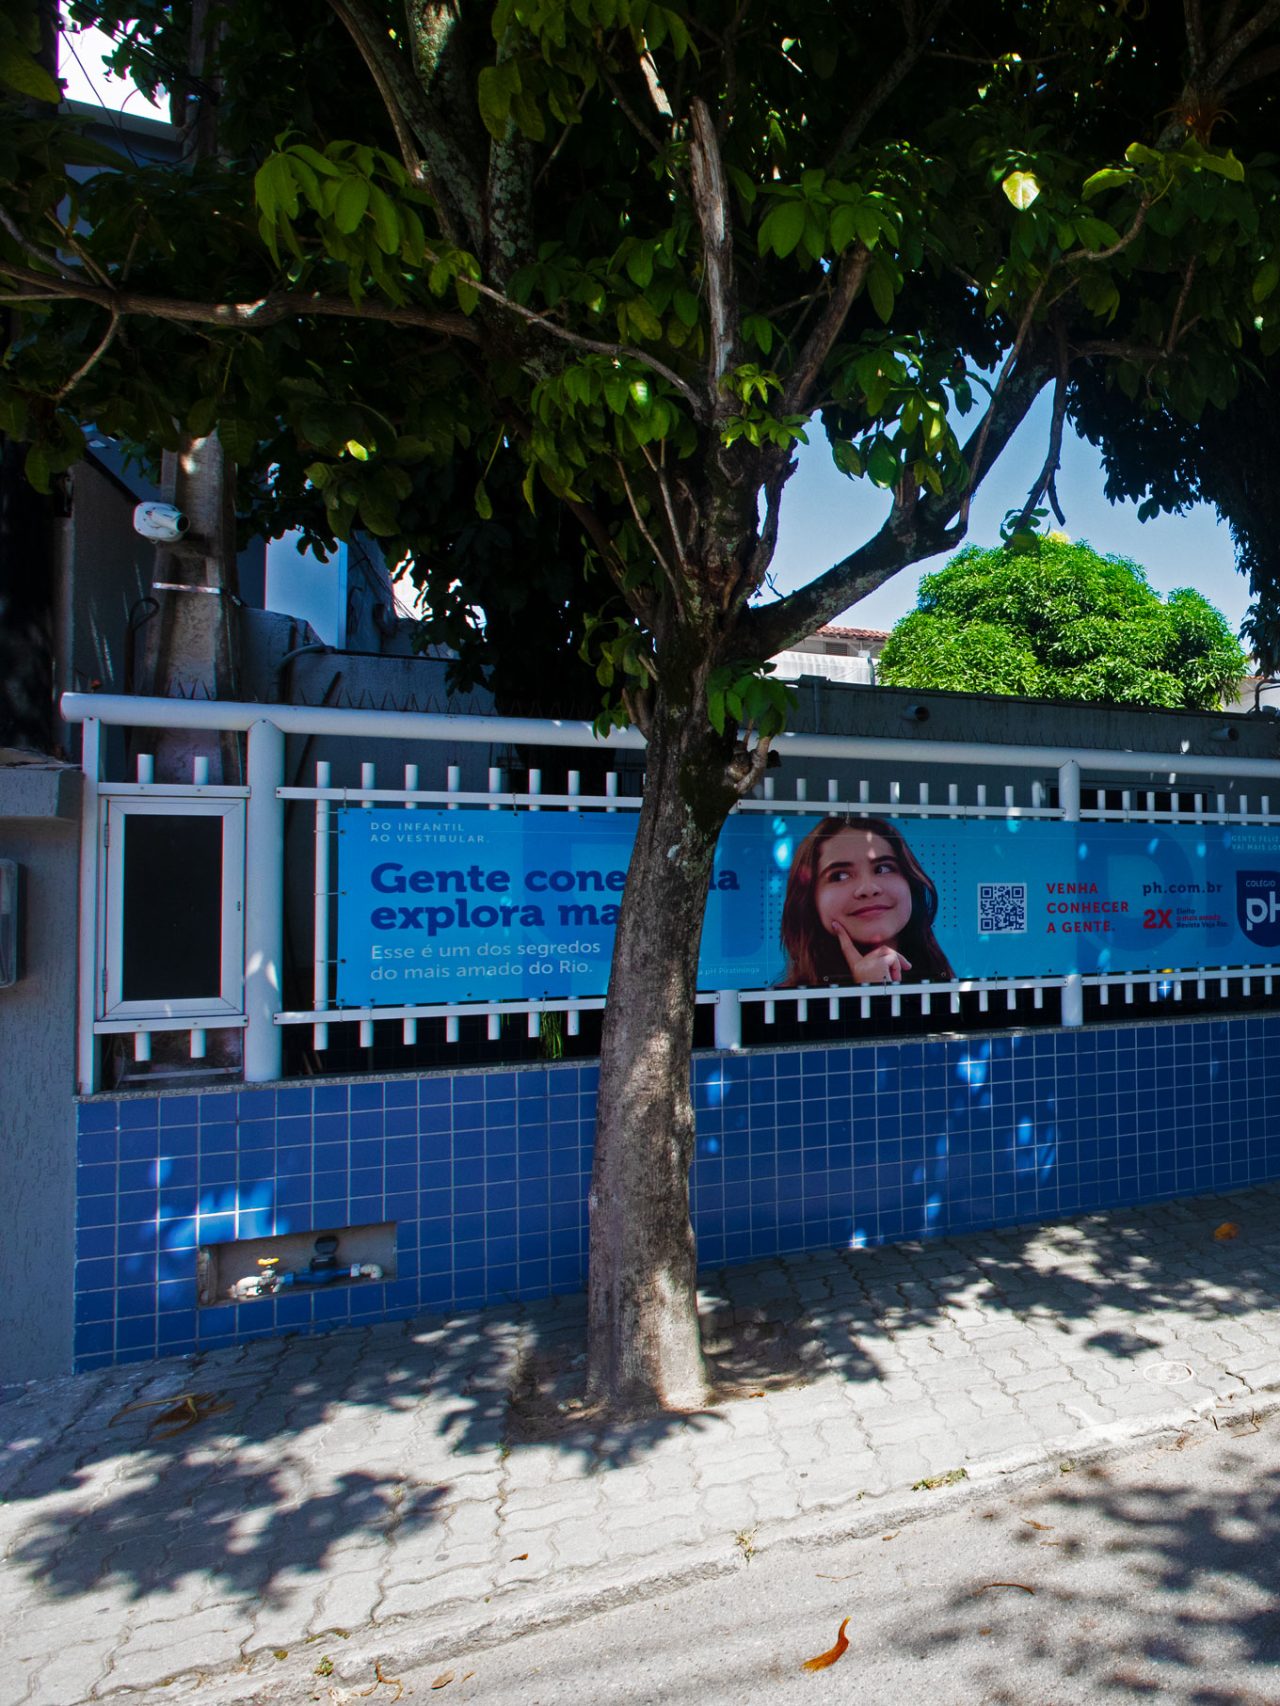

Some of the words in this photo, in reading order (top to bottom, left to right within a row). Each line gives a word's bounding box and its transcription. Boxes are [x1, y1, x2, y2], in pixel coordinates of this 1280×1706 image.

[370, 822, 391, 831] DO
[398, 823, 465, 832] INFANTIL
[370, 834, 390, 842] AO
[371, 862, 511, 893] Gente
[1046, 882, 1098, 894] VENHA
[1143, 882, 1223, 897] ph.com.br
[1046, 901, 1129, 914] CONHECER
[371, 898, 545, 936] explora
[1143, 908, 1173, 929] 2X
[1046, 922, 1056, 934] A
[371, 945, 415, 960] Esse
[422, 943, 433, 958] é
[439, 946, 470, 957] um
[477, 942, 511, 956] dos
[518, 940, 600, 959] segredos
[371, 966, 397, 981] do
[405, 964, 450, 979] mais
[456, 961, 523, 977] amado
[529, 961, 553, 975] do
[560, 960, 592, 974] Rio.
